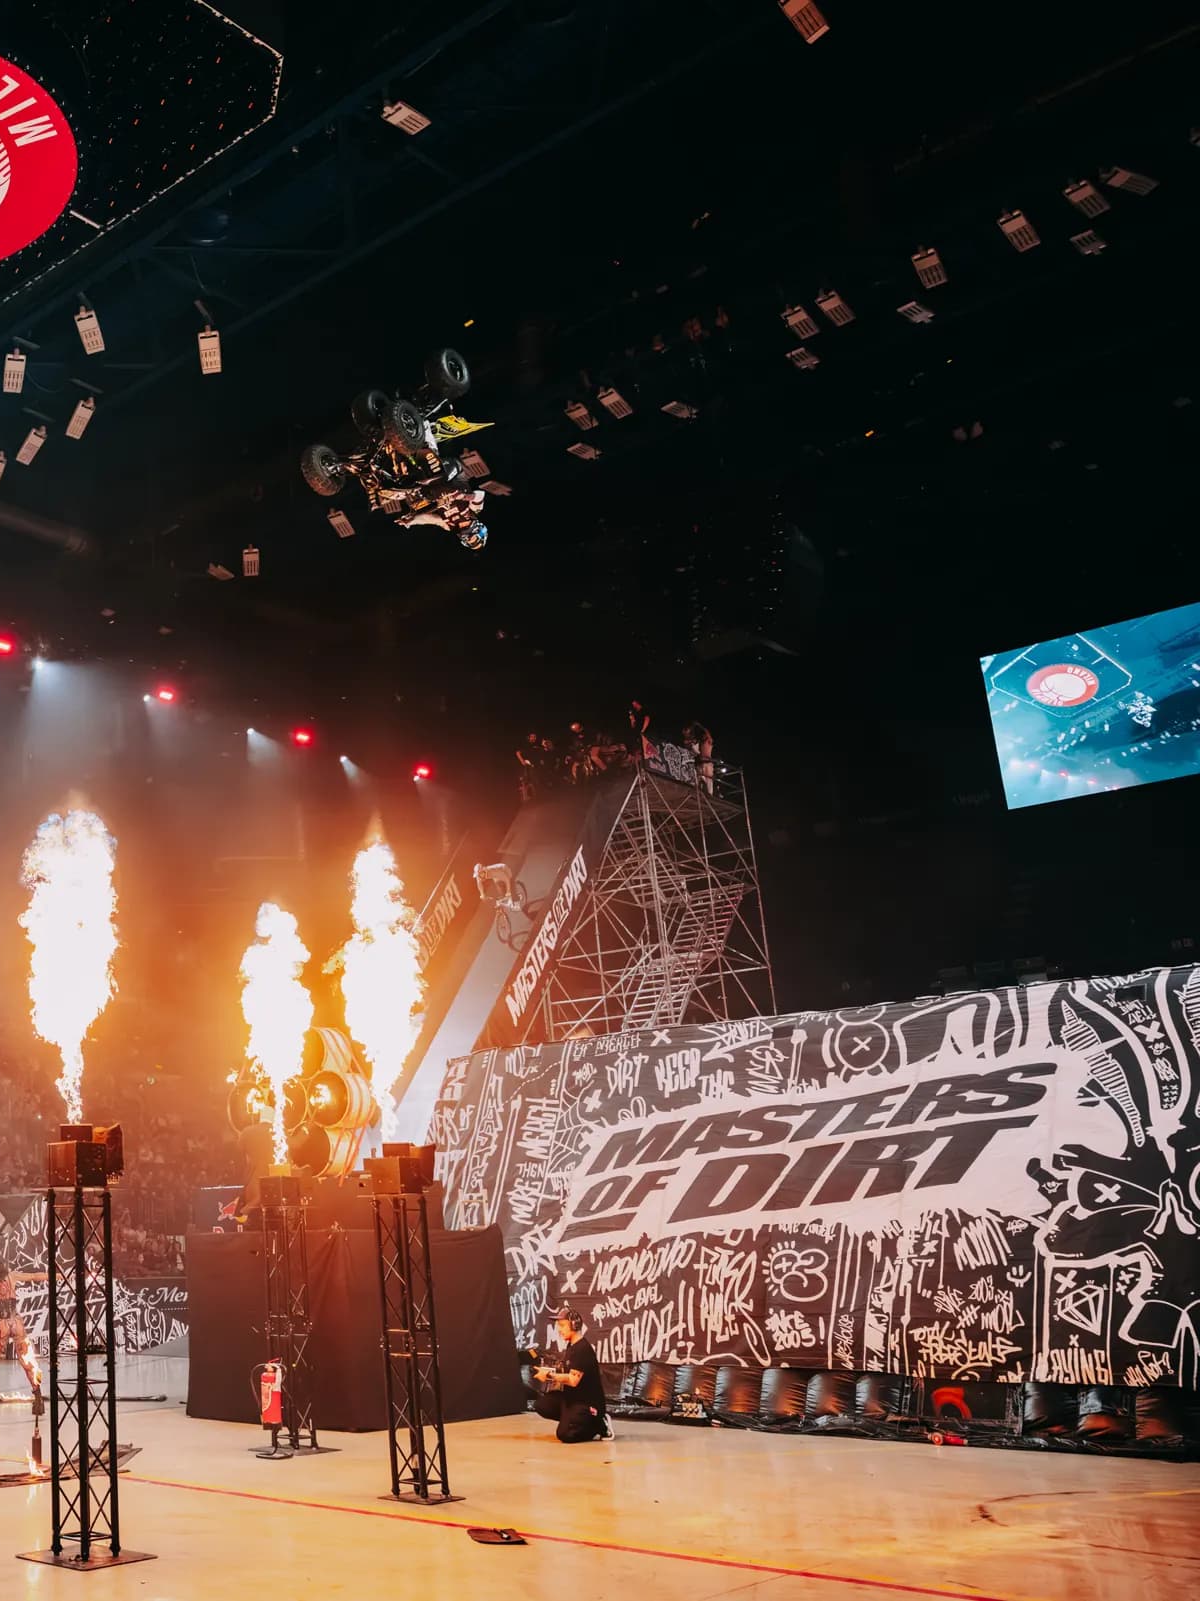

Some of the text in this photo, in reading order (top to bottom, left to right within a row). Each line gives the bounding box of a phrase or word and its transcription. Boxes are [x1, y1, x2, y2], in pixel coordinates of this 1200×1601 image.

[505, 911, 557, 1027] MASTERS
[585, 1063, 1057, 1175] MASTERS
[654, 1048, 700, 1097] KEEP
[572, 1167, 680, 1218] OF
[666, 1116, 1039, 1224] DIRT
